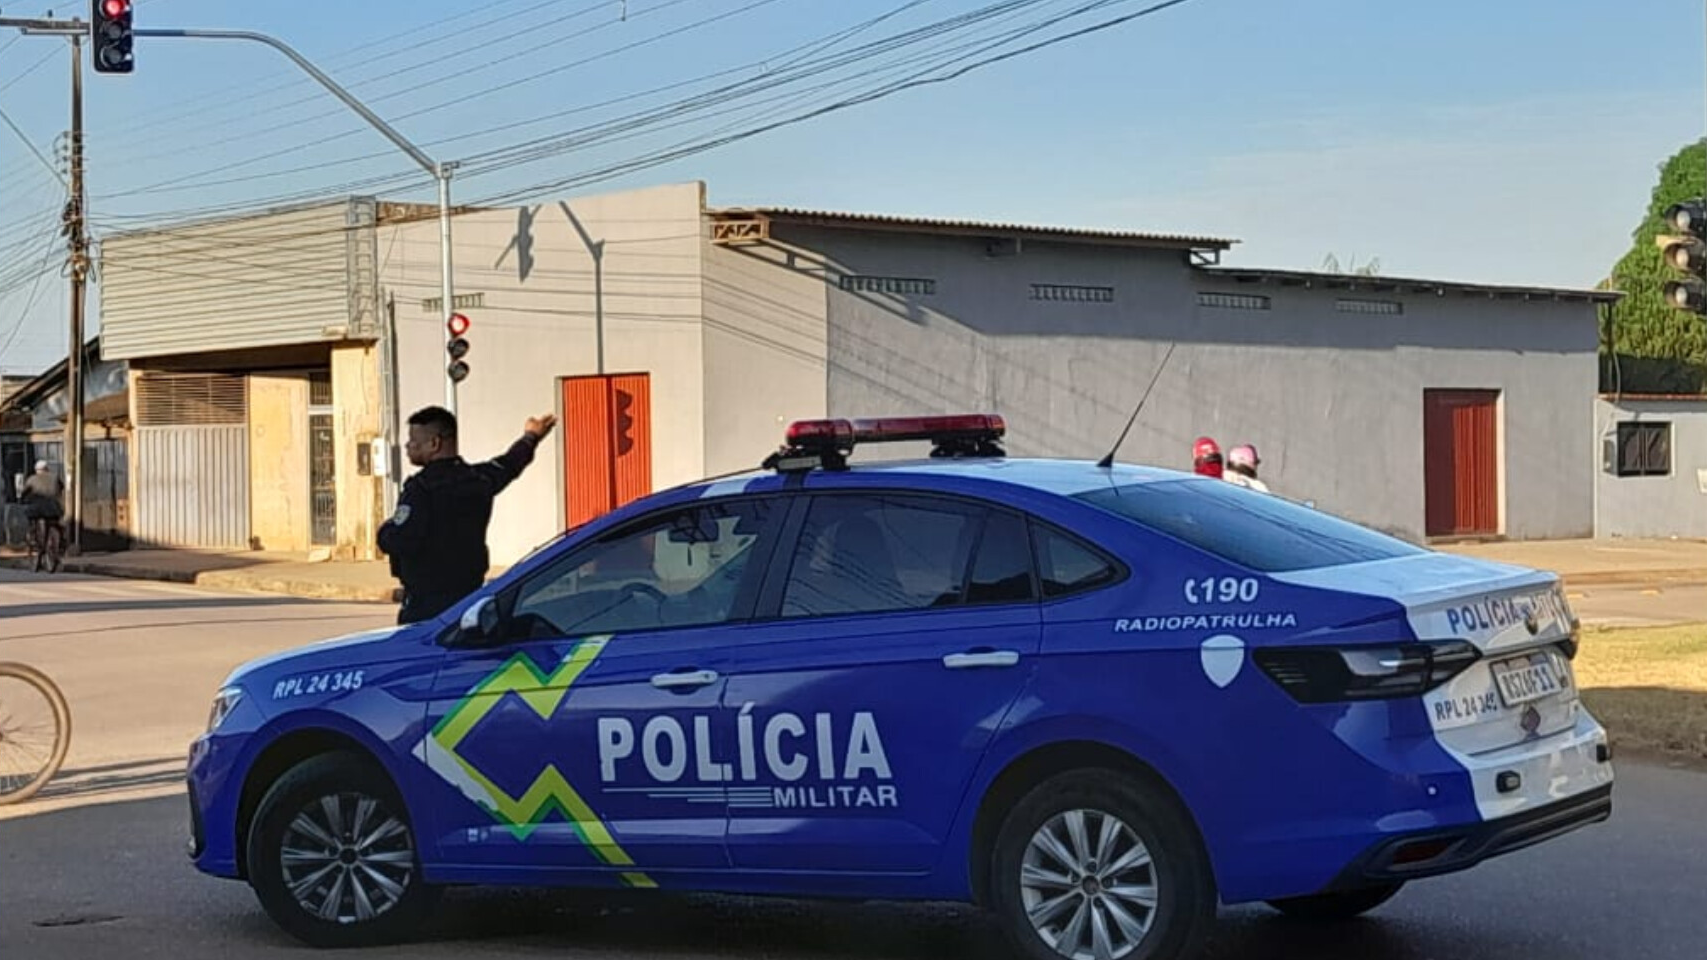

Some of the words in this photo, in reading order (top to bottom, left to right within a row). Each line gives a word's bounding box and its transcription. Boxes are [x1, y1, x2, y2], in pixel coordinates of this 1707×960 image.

[1200, 576, 1260, 603] 190
[1114, 613, 1297, 633] RADIOPATRULHA
[272, 677, 303, 700] RPL
[306, 673, 330, 693] 24
[331, 670, 365, 691] 345
[1434, 696, 1462, 721] RPL
[597, 701, 893, 782] POLÍCIA
[773, 785, 898, 808] MILITAR
